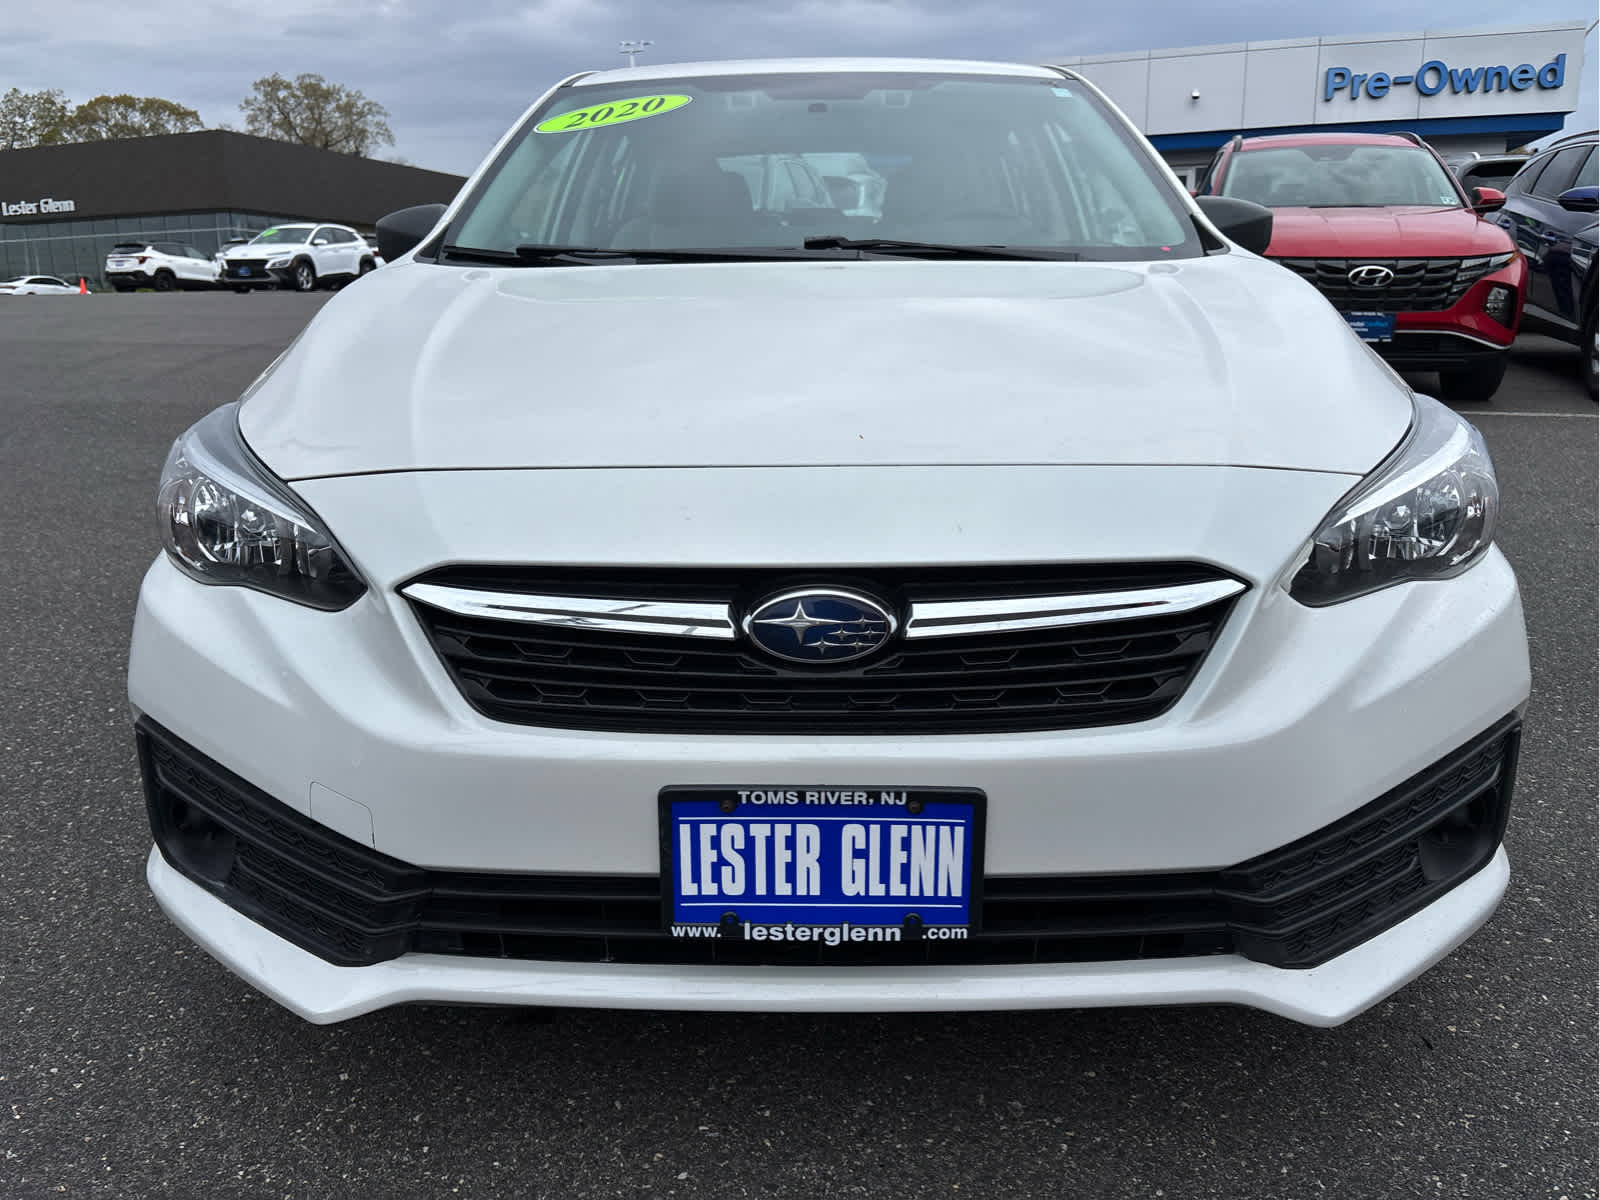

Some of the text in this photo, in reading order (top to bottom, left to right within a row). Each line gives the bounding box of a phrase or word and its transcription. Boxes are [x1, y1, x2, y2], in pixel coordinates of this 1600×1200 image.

[1324, 53, 1567, 102] Pre-Owned
[563, 97, 666, 129] 2020
[1, 200, 39, 216] Lester
[738, 791, 907, 806] TOMS RIVER, NJ
[679, 823, 965, 897] LESTER GLENN
[744, 922, 901, 946] lesterglenn
